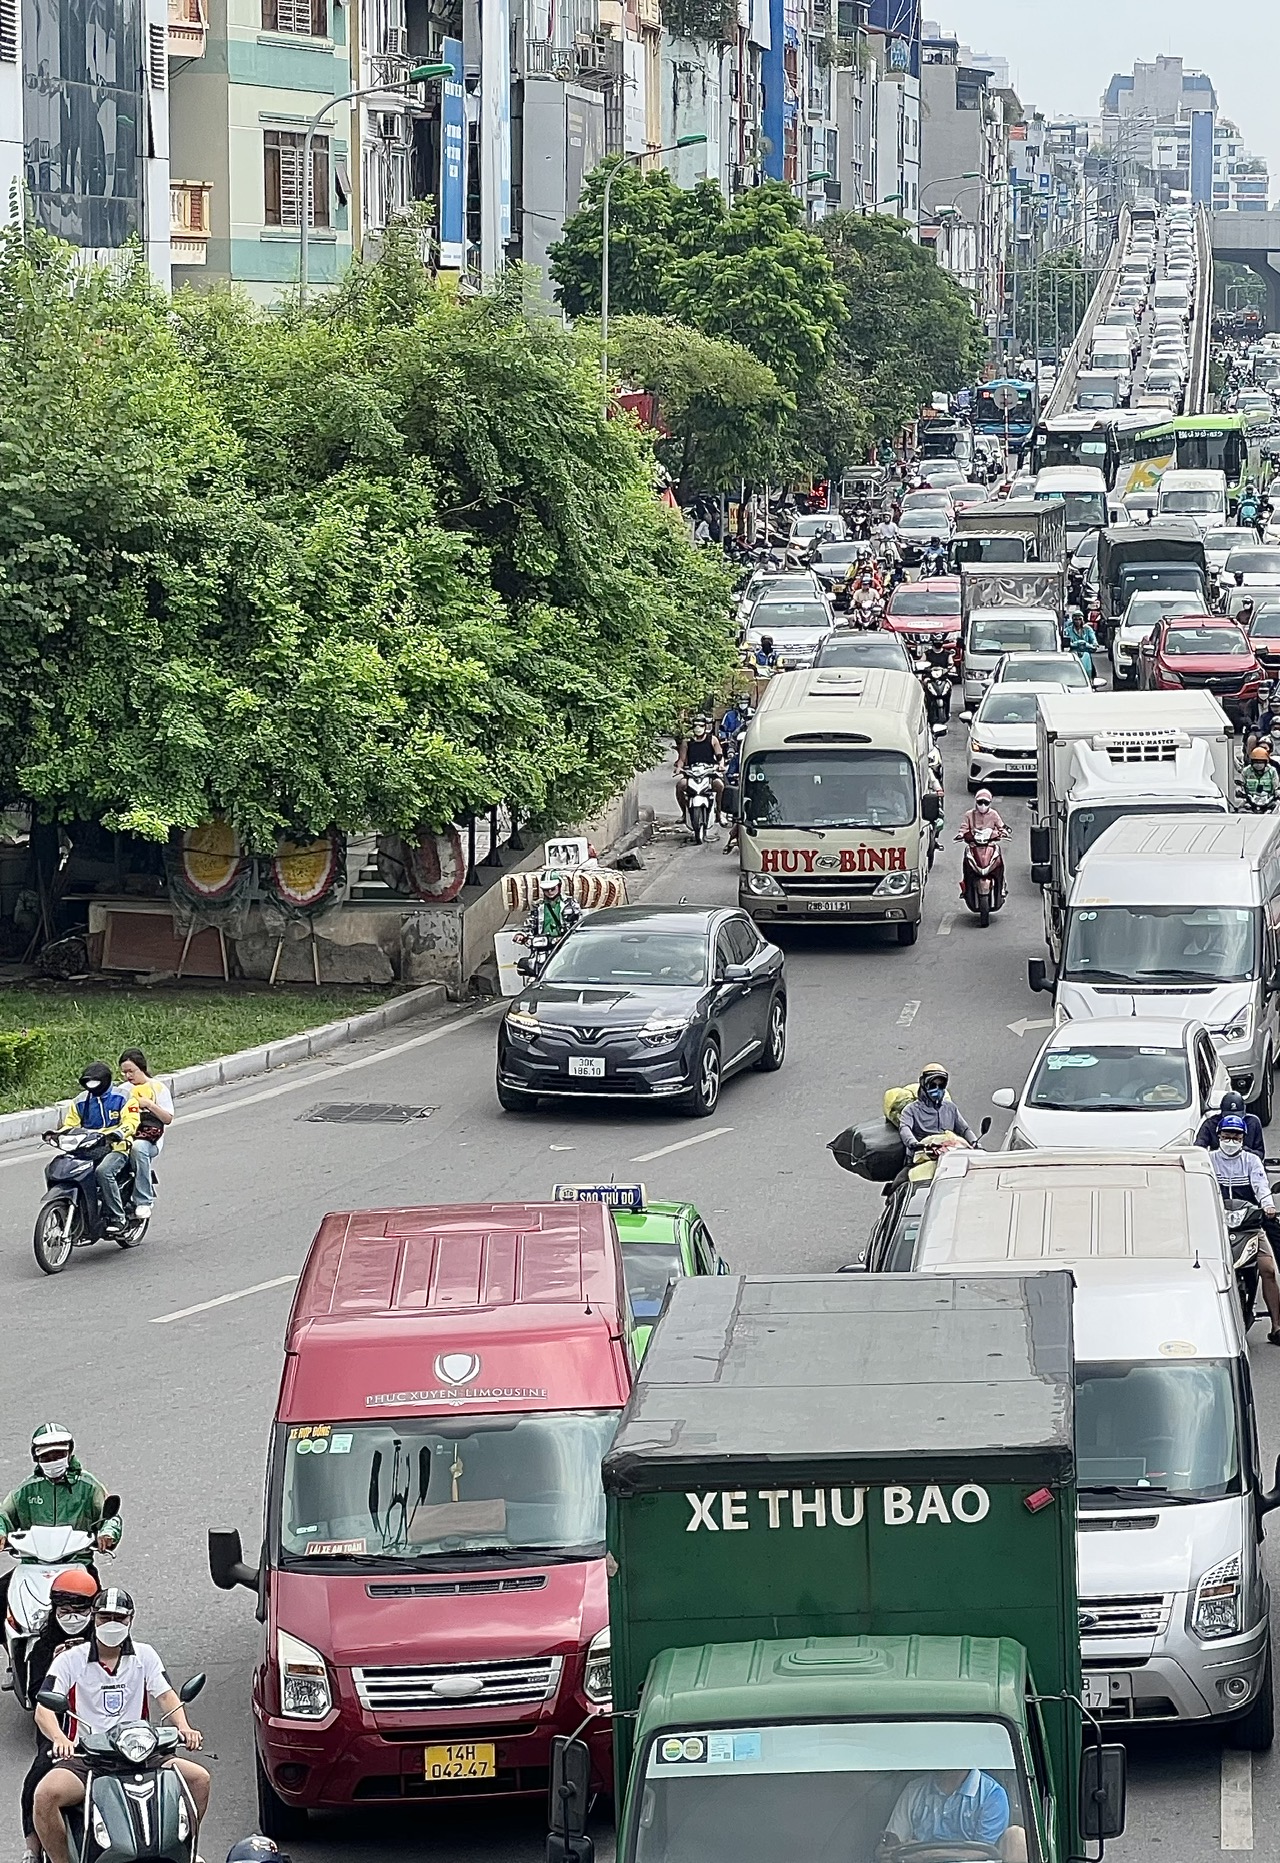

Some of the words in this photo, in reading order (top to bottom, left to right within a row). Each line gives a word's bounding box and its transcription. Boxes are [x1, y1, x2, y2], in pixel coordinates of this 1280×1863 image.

[761, 849, 819, 872] HUY
[839, 843, 906, 872] BÌNH
[465, 1387, 548, 1398] LIMOUSINE
[685, 1491, 750, 1532] XE
[321, 1545, 331, 1554] XE
[332, 1544, 343, 1553] AN
[1085, 1693, 1102, 1706] 17
[446, 1745, 476, 1761] 14H
[431, 1761, 488, 1778] 042.47
